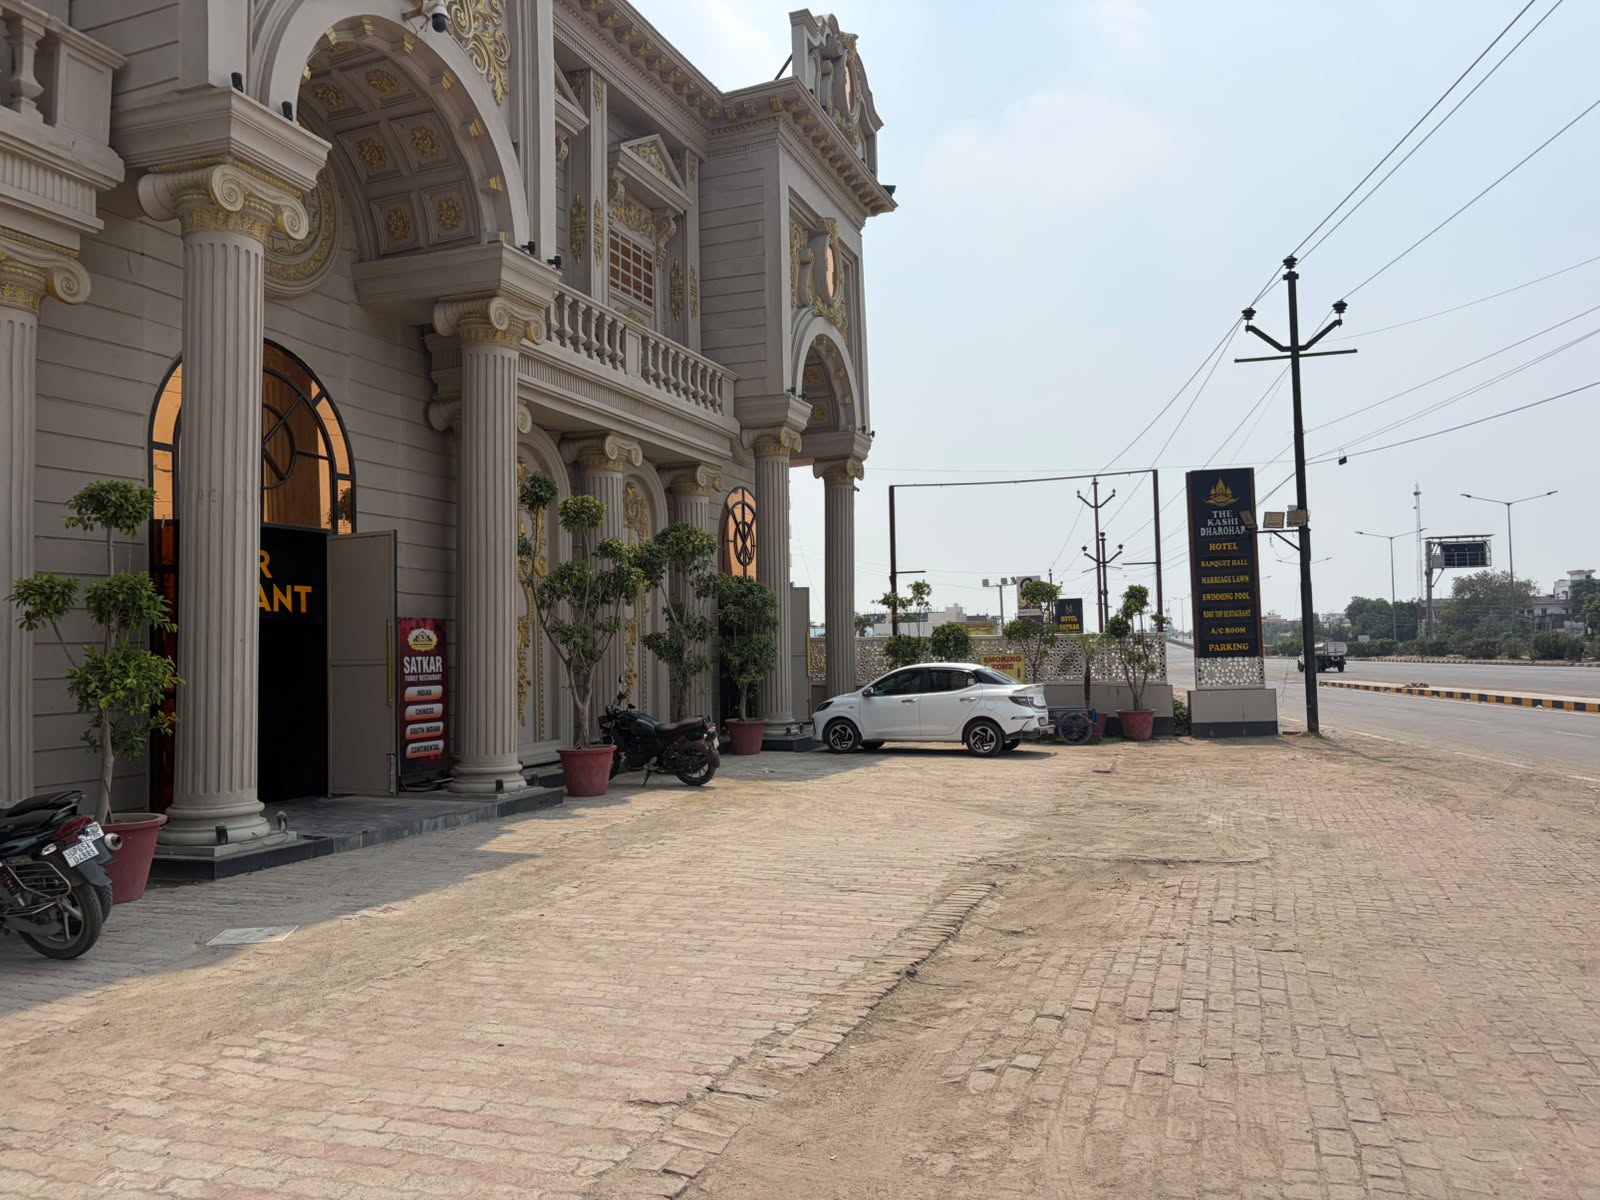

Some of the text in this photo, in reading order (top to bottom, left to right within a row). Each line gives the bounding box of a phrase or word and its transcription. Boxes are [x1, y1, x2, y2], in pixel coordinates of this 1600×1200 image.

[1211, 510, 1233, 519] THE
[1207, 518, 1239, 527] KASHI
[1209, 542, 1239, 551] HOTEL
[1200, 560, 1231, 568] BANQUET
[1201, 574, 1249, 584] MARRIAGE LAWN
[1202, 591, 1251, 601] SWIMMING POOL
[1208, 642, 1249, 652] PARKING
[403, 655, 443, 674] SATKAR
[415, 707, 434, 715] CHINESE
